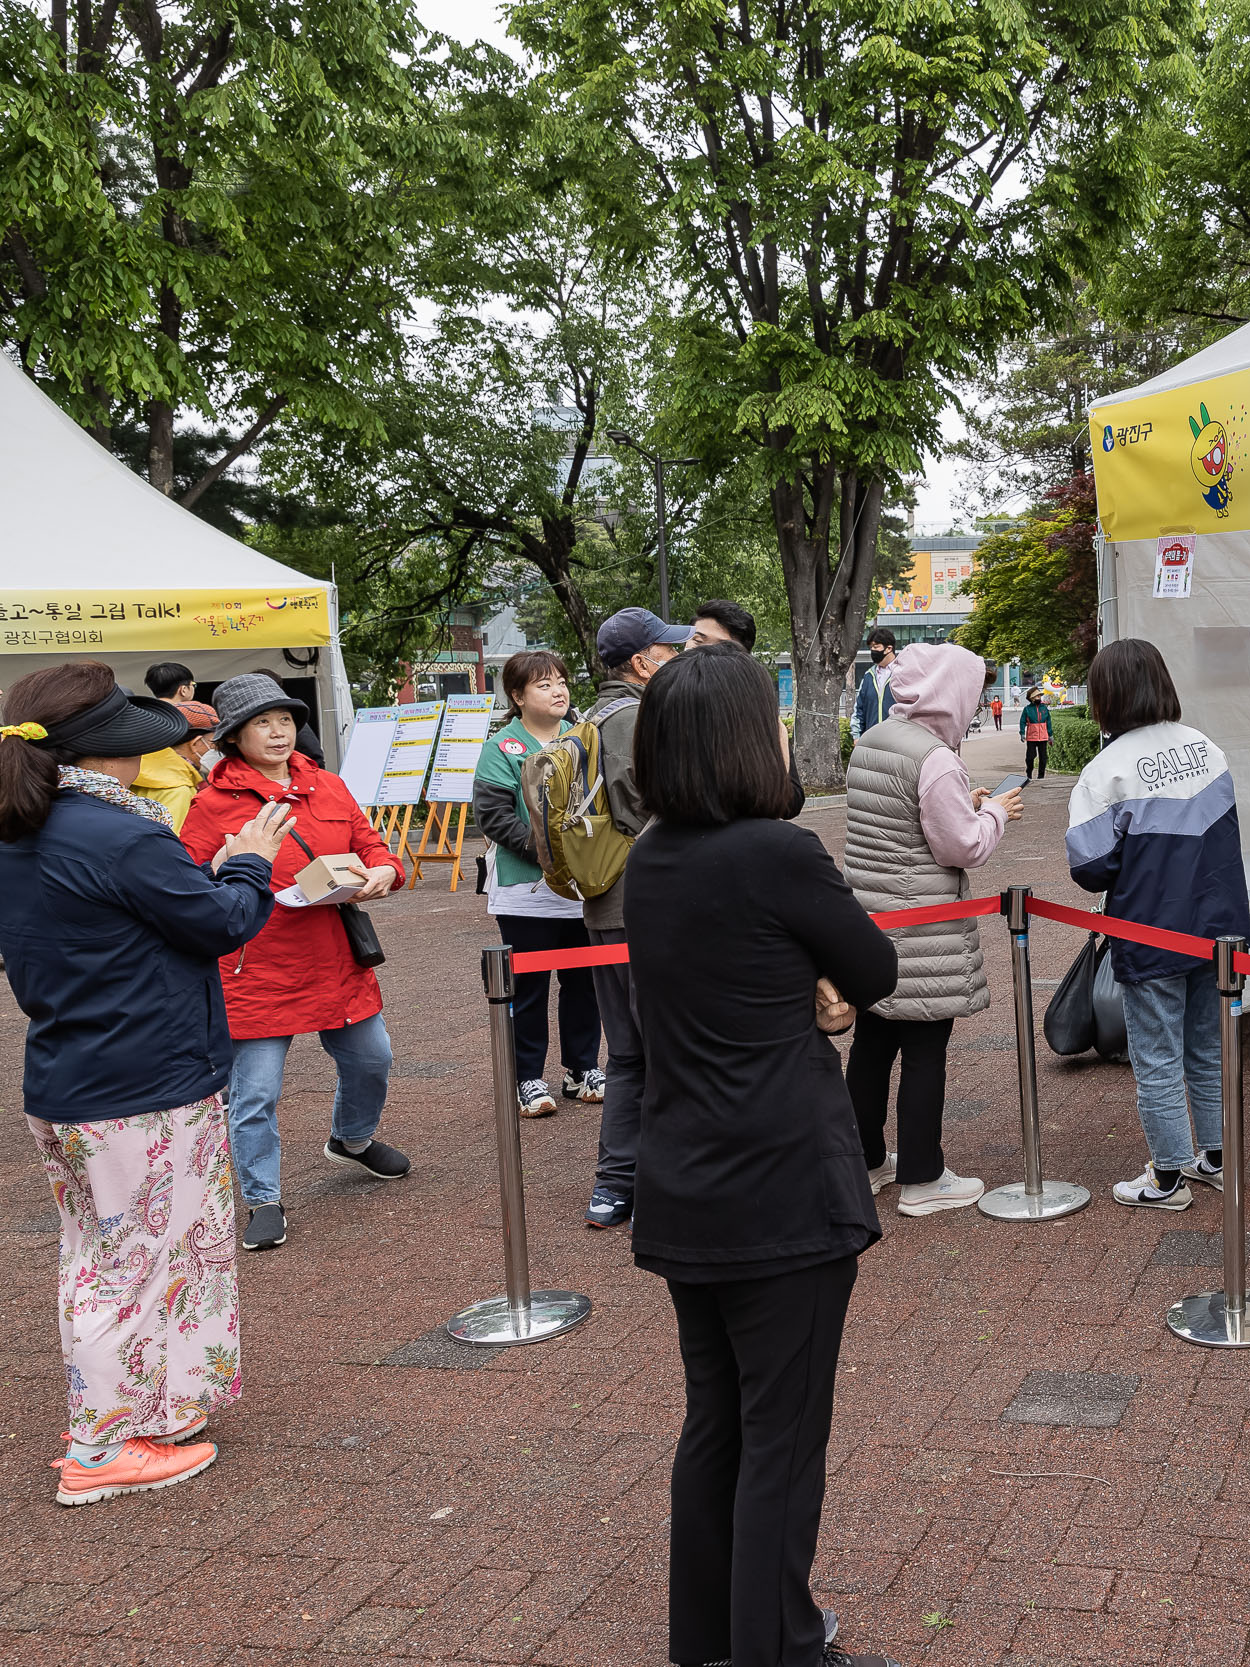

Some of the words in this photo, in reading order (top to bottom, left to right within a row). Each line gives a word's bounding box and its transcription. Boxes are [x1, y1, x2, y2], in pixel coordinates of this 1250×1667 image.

[1116, 422, 1153, 447] 광진구
[132, 602, 181, 619] Talk!
[4, 630, 104, 646] 광진구협의회
[1136, 743, 1208, 784] CALIF
[1148, 781, 1166, 792] USA
[1168, 768, 1210, 784] PROPERTY
